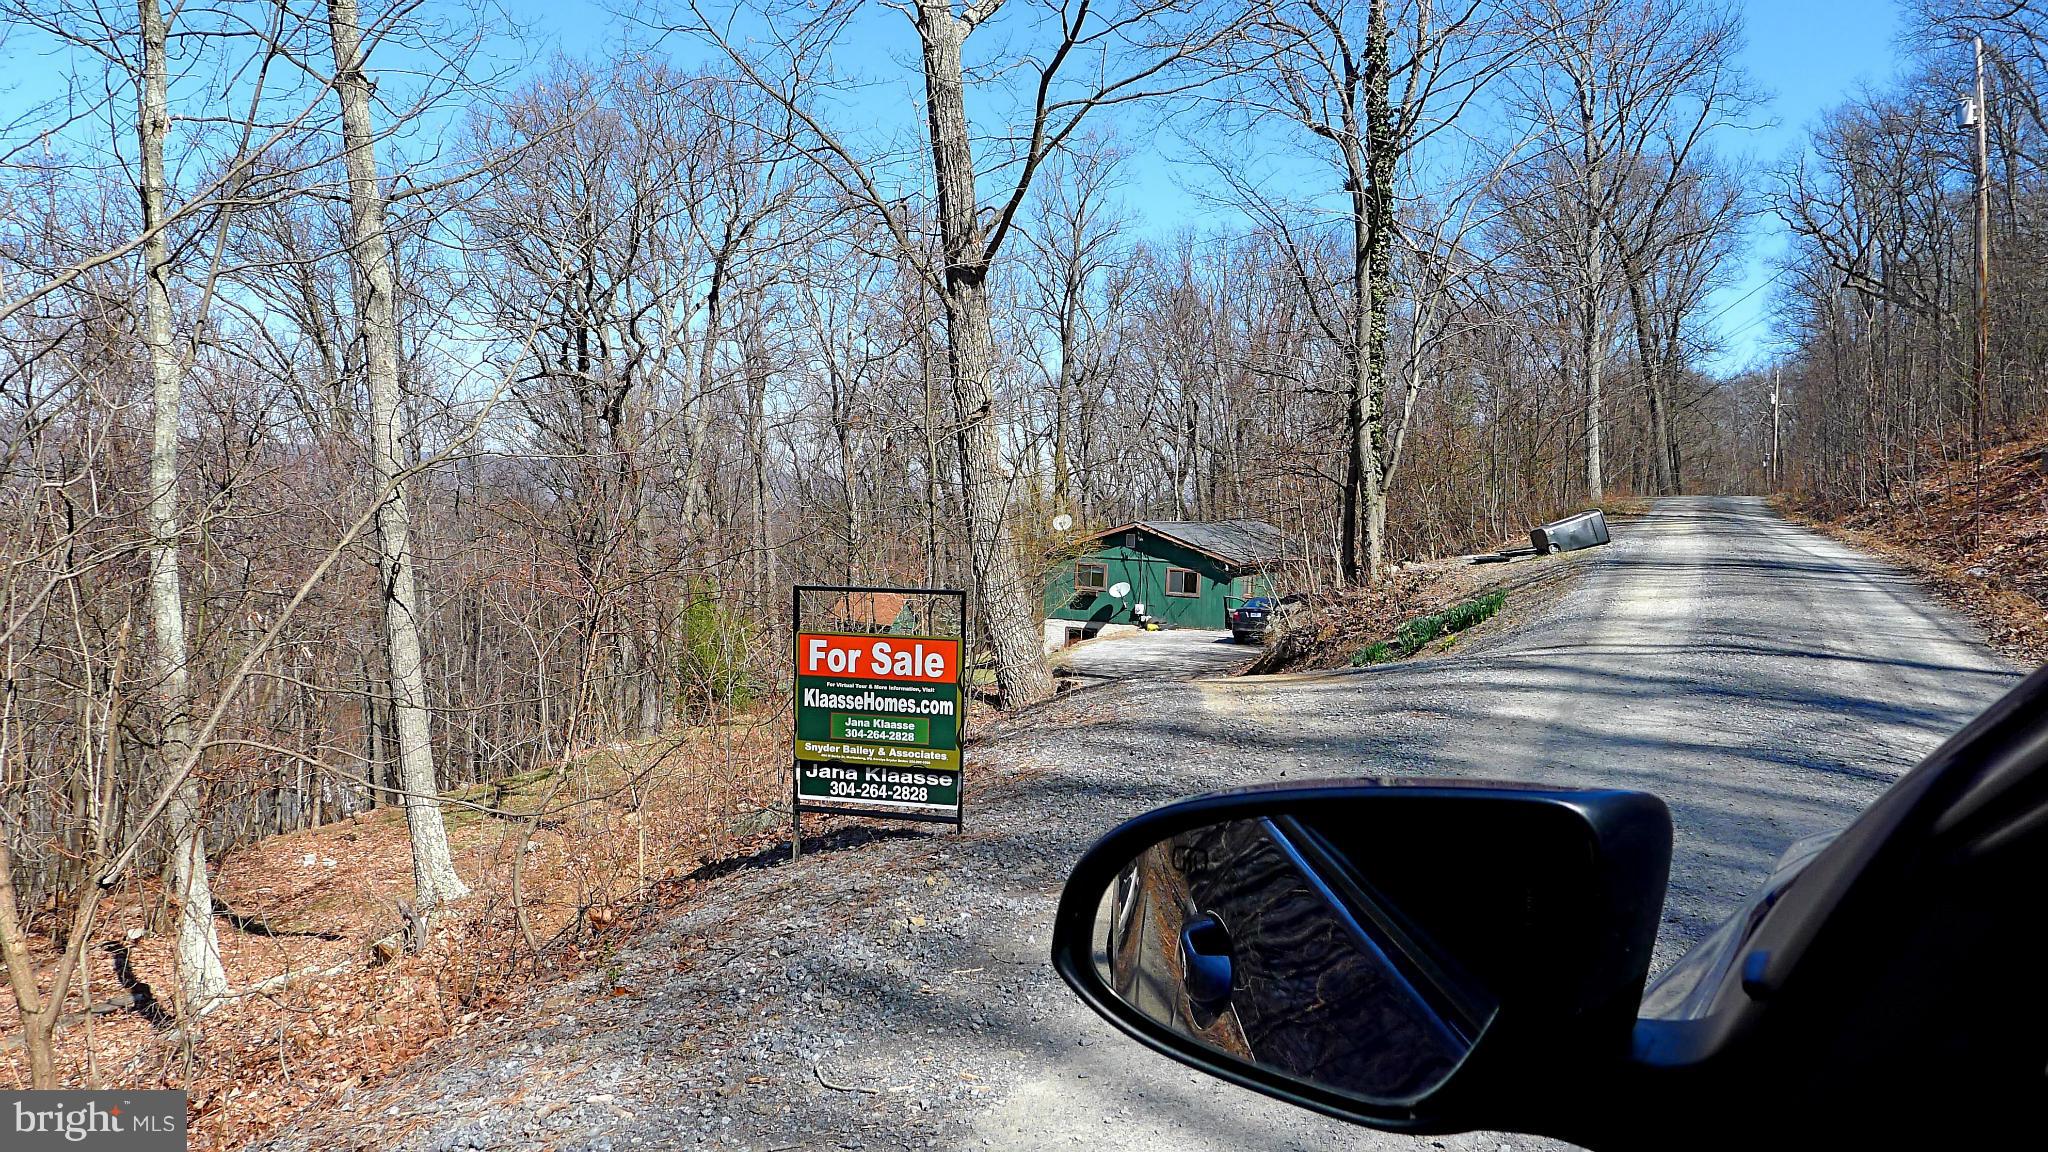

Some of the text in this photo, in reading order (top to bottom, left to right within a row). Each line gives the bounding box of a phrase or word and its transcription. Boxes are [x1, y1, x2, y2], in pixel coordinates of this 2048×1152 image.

[809, 639, 945, 678] For Sale
[804, 688, 954, 716] KlaasseHomes.com
[845, 717, 915, 731] Jana Klaasse
[845, 728, 915, 742] 304-264-2828
[804, 742, 840, 754] Snyder
[843, 745, 875, 757] Bailey
[878, 747, 886, 756] &
[806, 764, 953, 787] Jana Klaasse
[830, 781, 928, 802] 304-264-2828
